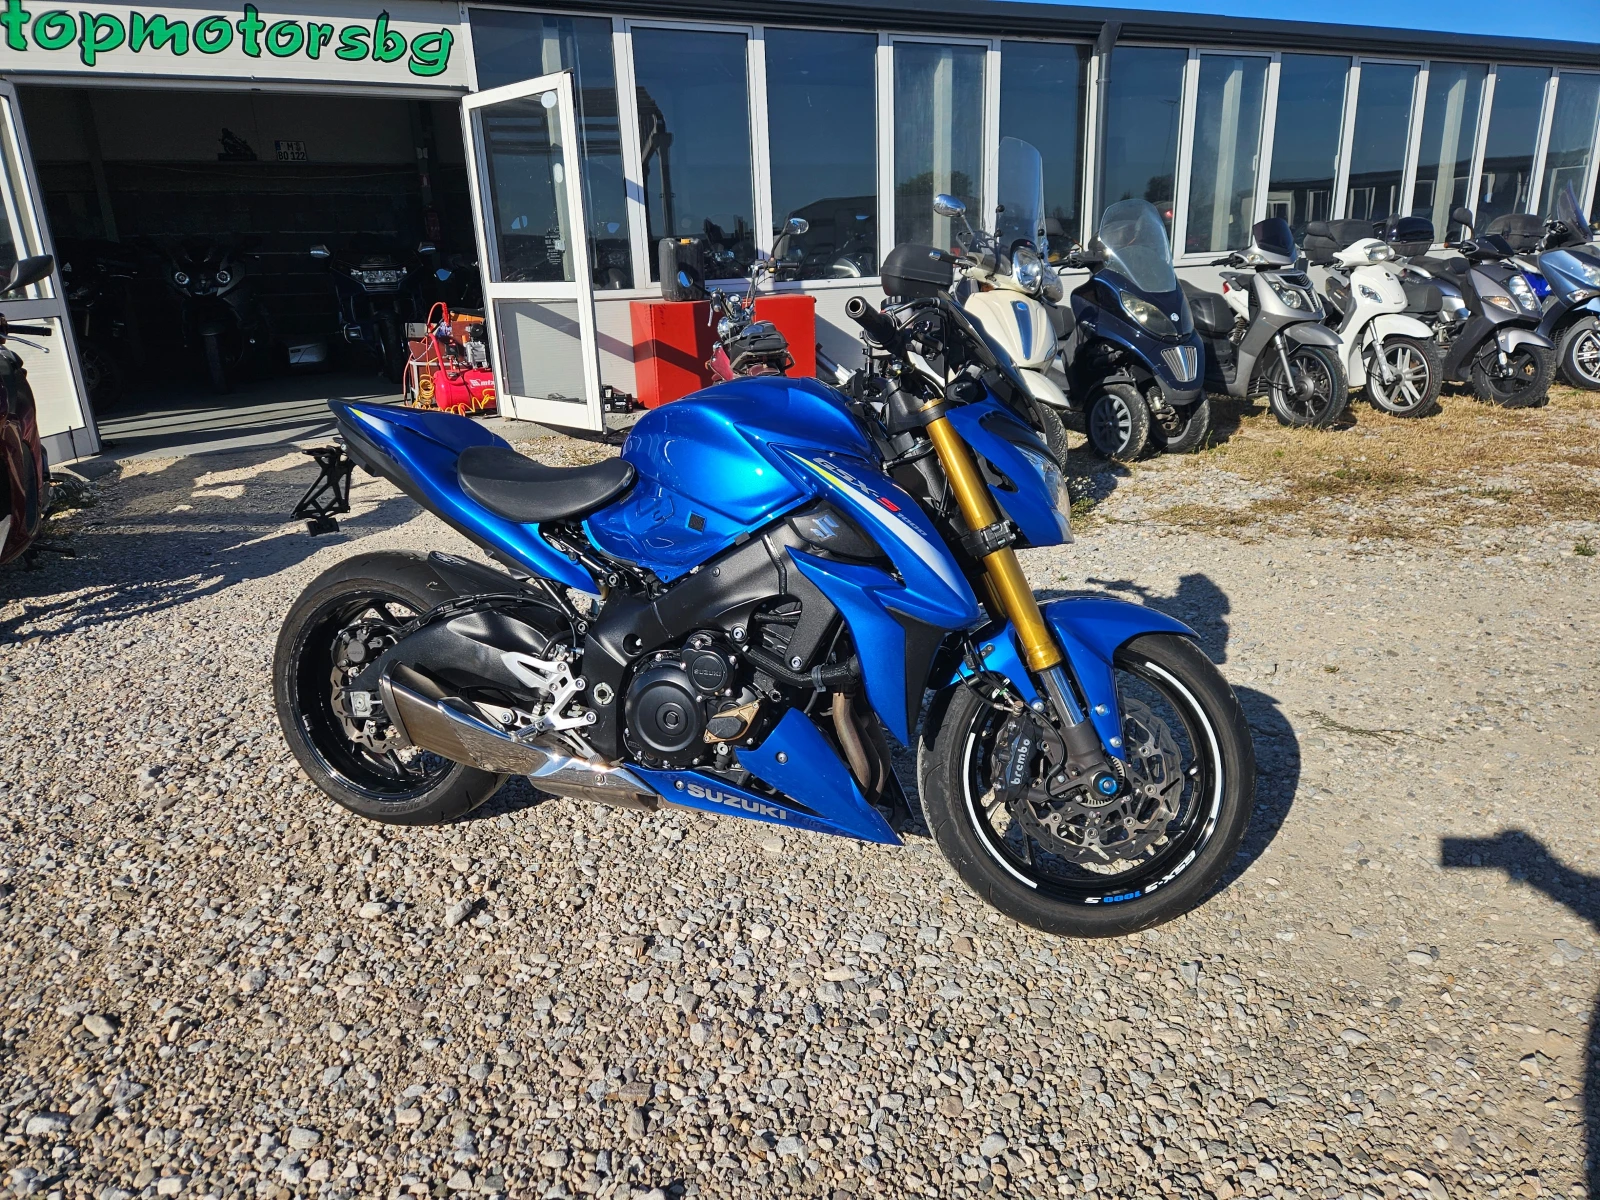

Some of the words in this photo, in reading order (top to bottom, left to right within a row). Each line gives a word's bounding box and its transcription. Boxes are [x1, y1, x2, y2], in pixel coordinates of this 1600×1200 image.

[0, 0, 454, 76] topmotorsbg
[813, 457, 901, 512] GSX-S
[693, 668, 722, 677] SUZUKI
[1010, 738, 1030, 785] brembo
[380, 803, 420, 812] DUNLOP
[687, 783, 787, 820] SUZUKI
[1103, 890, 1142, 903] 1000
